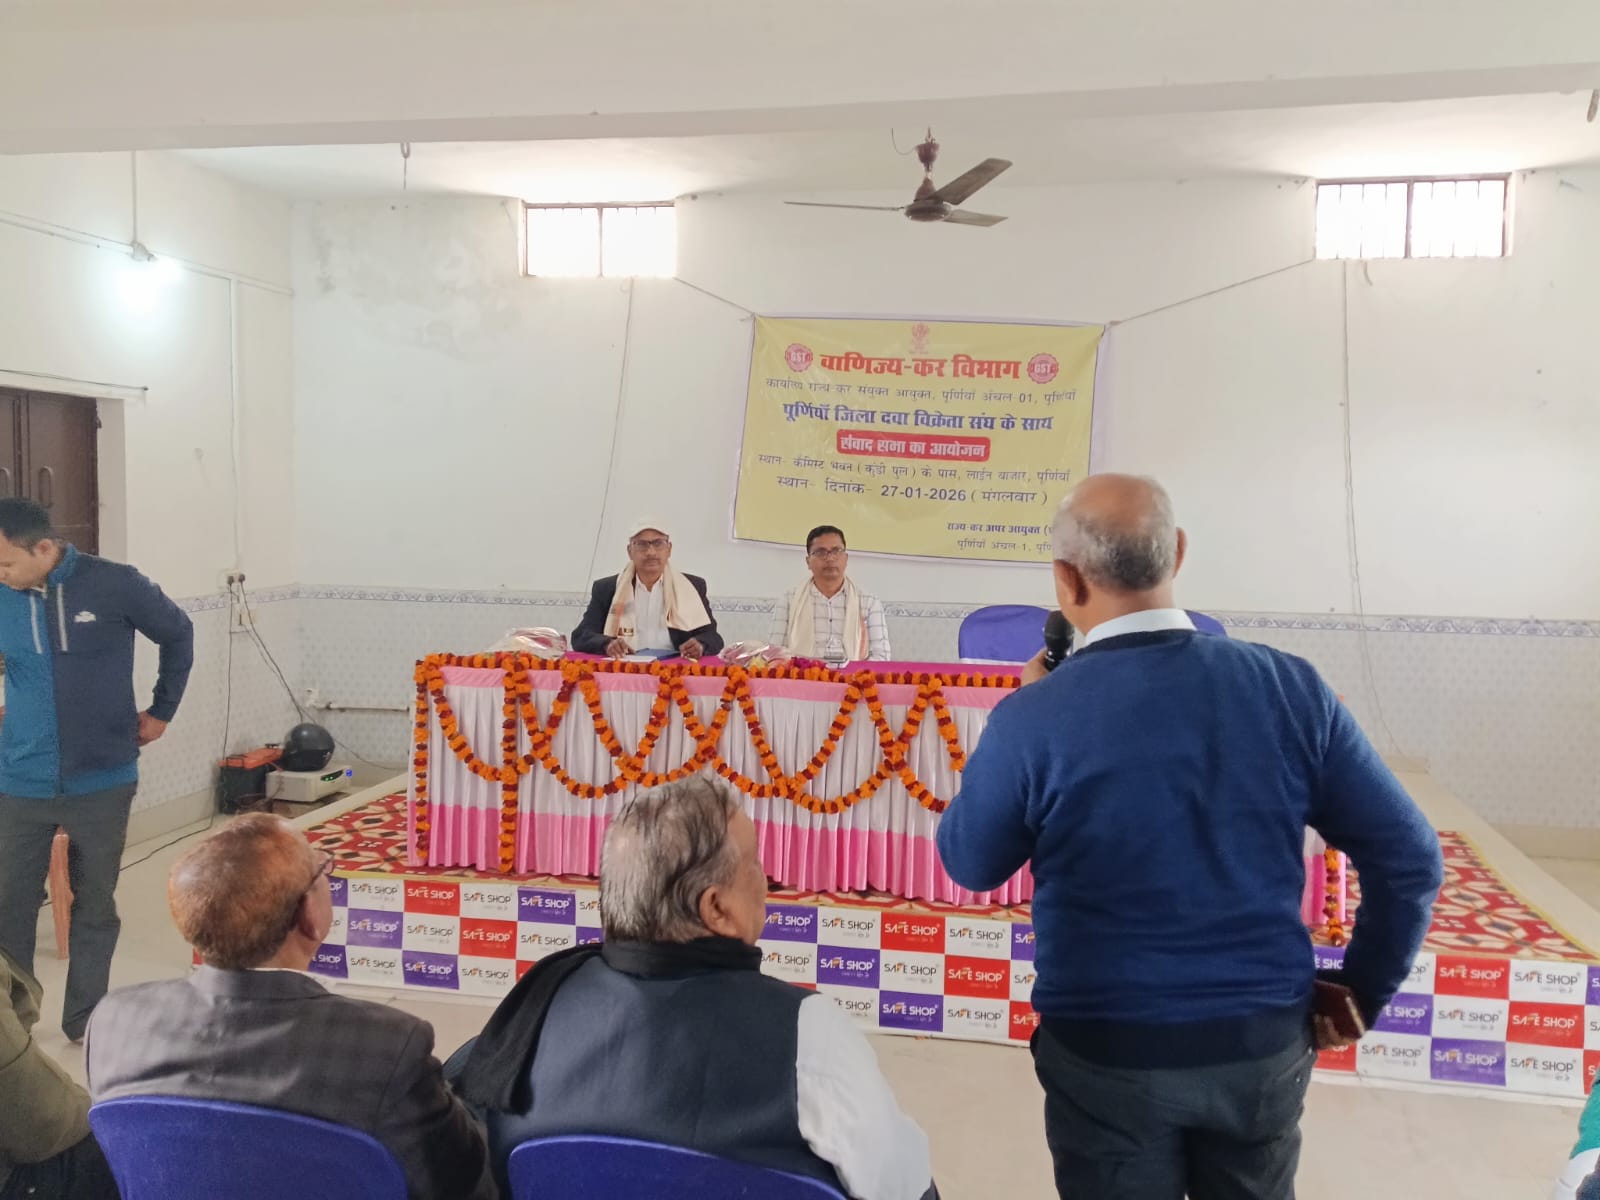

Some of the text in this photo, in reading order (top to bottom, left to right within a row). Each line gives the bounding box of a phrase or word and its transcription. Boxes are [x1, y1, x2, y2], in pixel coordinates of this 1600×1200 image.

[820, 352, 947, 377] वाणिज्य-कर
[834, 404, 877, 424] जिला
[880, 409, 909, 426] दवा
[1000, 413, 1018, 430] के
[909, 441, 927, 455] का
[930, 441, 986, 457] आयोजन
[880, 484, 966, 502] 27-01-2026
[352, 883, 398, 895] SAFE SHOP
[407, 886, 429, 898] SAFE
[430, 890, 455, 900] SHOP
[463, 892, 511, 904] SAFE SHOP
[521, 895, 570, 909] SAFE SHOP
[350, 919, 372, 931] SAFE
[373, 922, 398, 933] SHOP
[765, 912, 811, 927] AFE SHOP
[822, 917, 874, 930] SAFE SHOP
[407, 925, 453, 937] SAFE SHOP
[462, 928, 511, 942] SAFE SHOP
[884, 921, 938, 936] SAFE SHOP
[949, 927, 1003, 941] SAFE SHOP
[521, 934, 542, 944] SAFE
[544, 936, 569, 946] SHOP
[318, 954, 342, 964] SHOP
[351, 957, 396, 969] SAFE SHOP
[784, 955, 810, 966] SHOP
[820, 957, 873, 971] SAFE SHOP
[404, 961, 427, 974] SAFE
[428, 964, 453, 975] SHOP
[462, 968, 483, 978] SAFE
[485, 970, 509, 979] SHOP
[884, 962, 937, 976] SAFE SHOP
[948, 967, 1003, 983] SAFE SHOP
[1440, 965, 1501, 980] SAFE SHOP
[1514, 971, 1542, 984] SAFE
[1546, 975, 1578, 986] SHOP
[845, 1000, 872, 1011] SHOP
[882, 1002, 907, 1015] SAFE
[909, 1005, 936, 1017] SHOP
[1394, 1006, 1426, 1018] SHOP
[947, 1008, 1002, 1021] SAFE SHOP
[1438, 1009, 1499, 1023] SAFE SHOP
[1512, 1013, 1575, 1028] SAFE SHOP
[1362, 1045, 1388, 1056] SAFE
[1391, 1048, 1422, 1059] SHOP
[1434, 1049, 1498, 1066] SAFE SHOP
[1511, 1057, 1538, 1070] SAFE
[1542, 1060, 1574, 1072] SHOP
